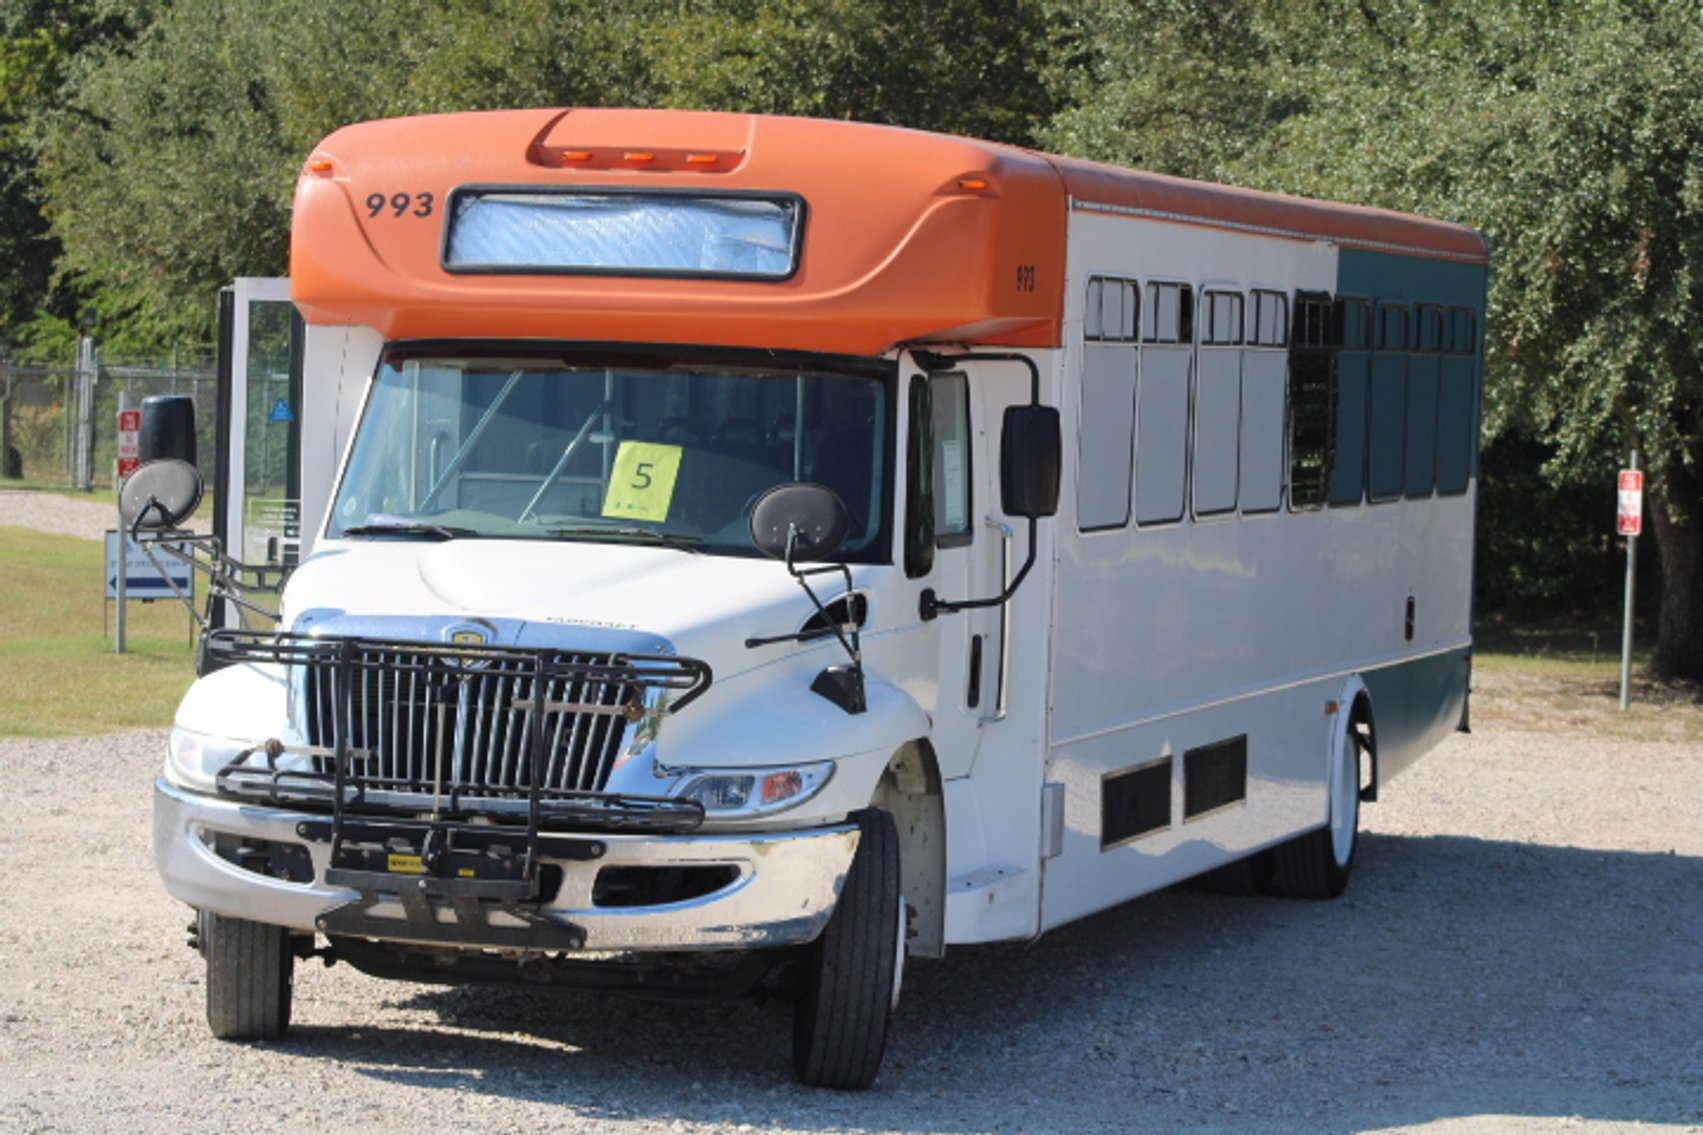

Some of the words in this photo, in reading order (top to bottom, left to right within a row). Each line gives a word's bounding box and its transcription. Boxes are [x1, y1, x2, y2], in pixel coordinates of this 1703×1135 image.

[366, 192, 434, 218] 993
[1016, 264, 1035, 292] 993
[631, 463, 654, 489] 5
